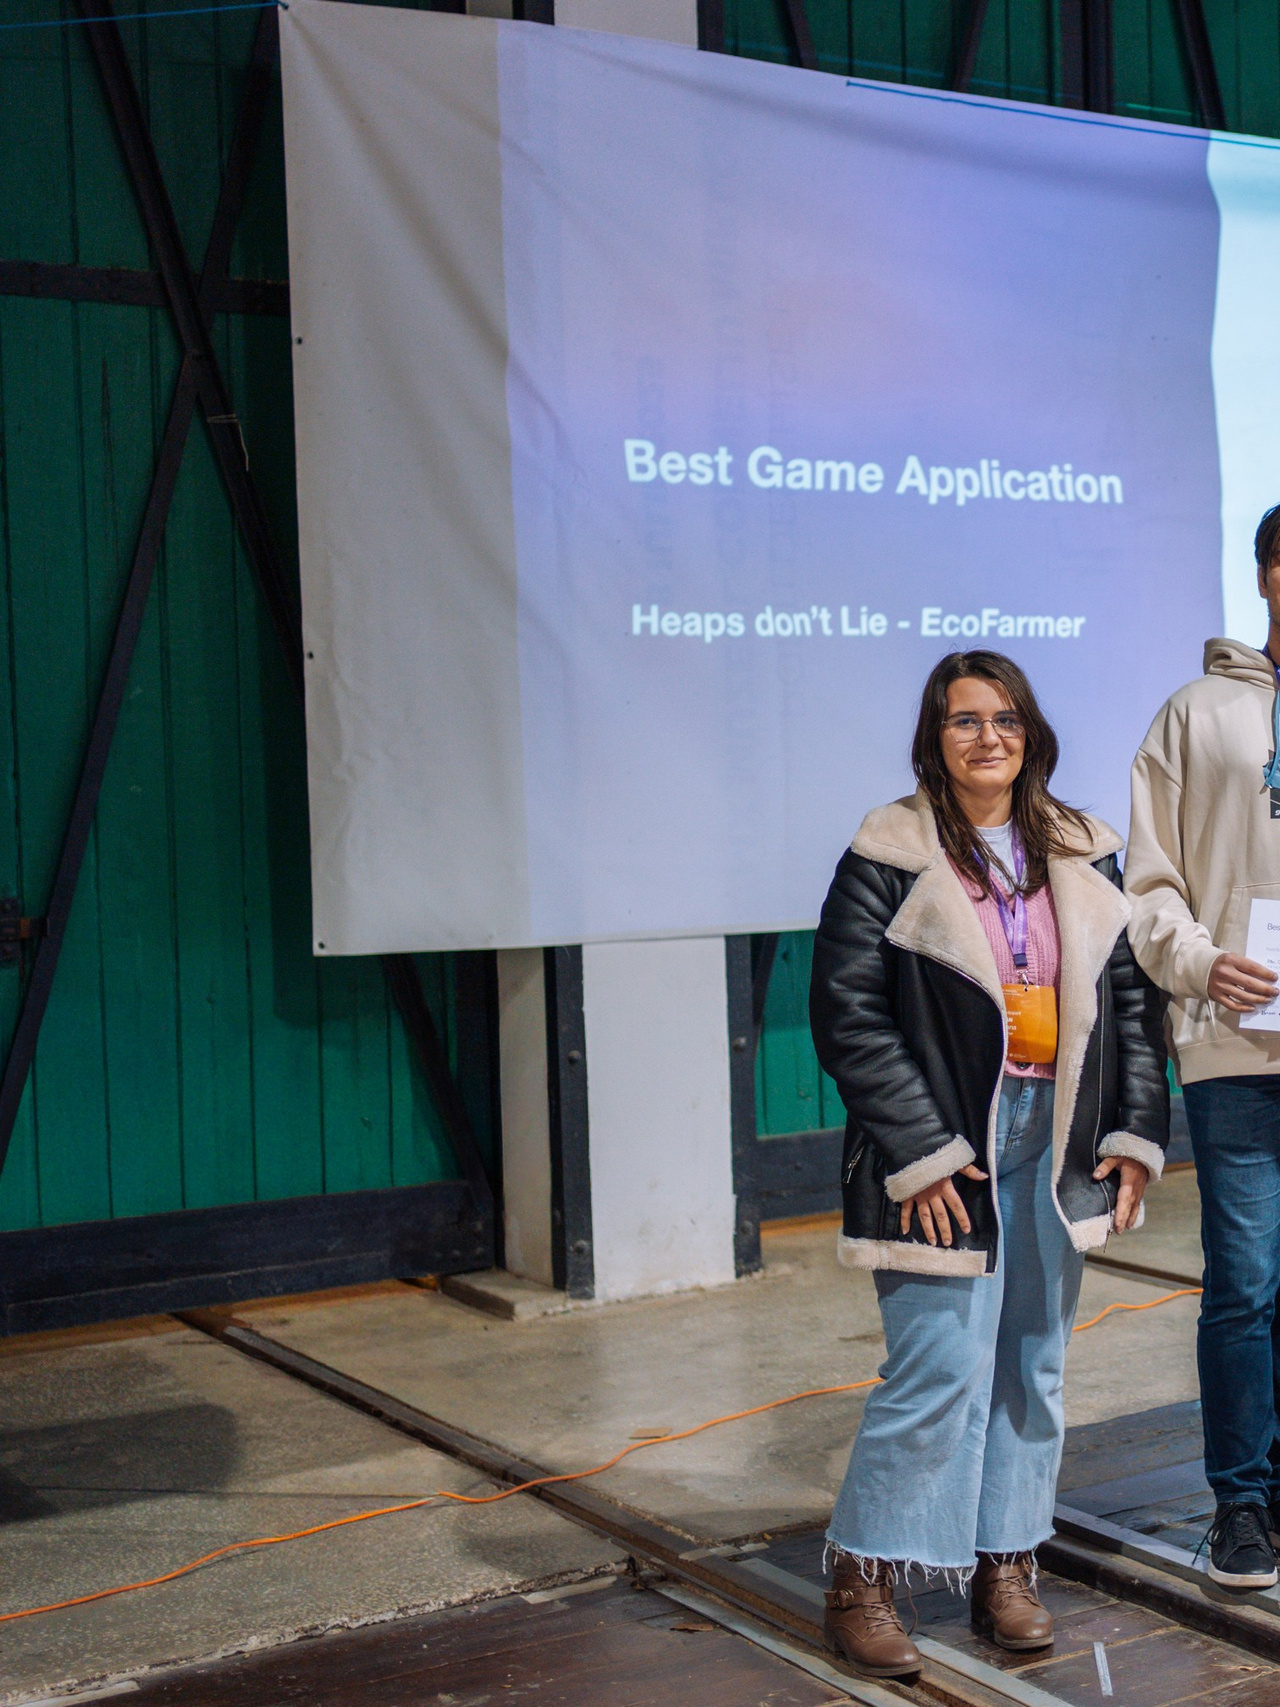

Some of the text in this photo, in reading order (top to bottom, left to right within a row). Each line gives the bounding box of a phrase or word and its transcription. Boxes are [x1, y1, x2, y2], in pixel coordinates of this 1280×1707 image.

[624, 439, 1124, 507] Best Game Application
[631, 604, 745, 643] Heaps
[754, 605, 833, 637] don't
[841, 606, 888, 636] Lie
[920, 607, 1086, 639] EcoFarmer
